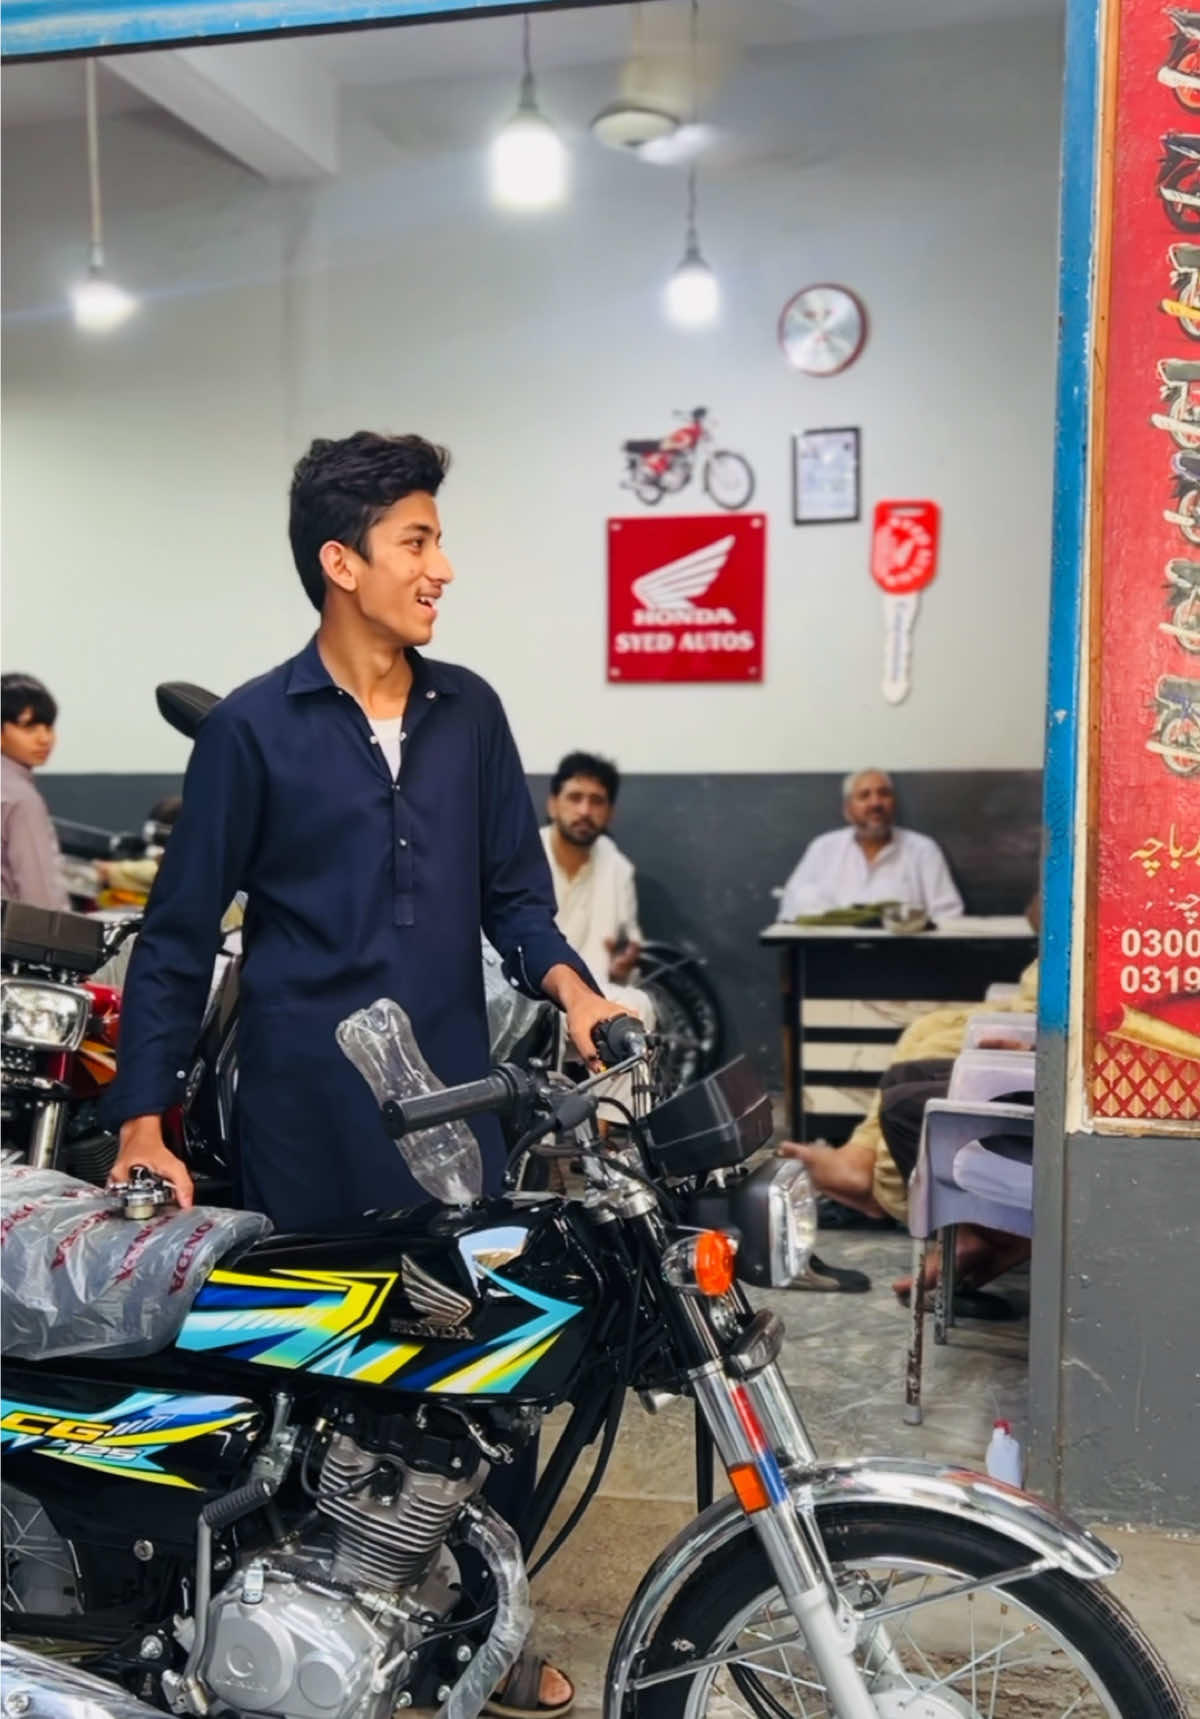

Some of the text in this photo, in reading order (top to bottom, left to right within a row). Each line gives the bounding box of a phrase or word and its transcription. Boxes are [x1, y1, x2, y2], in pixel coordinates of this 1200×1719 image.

[633, 607, 737, 626] HONDA
[678, 630, 755, 652] AUTOS
[1121, 928, 1200, 958] 0300
[1120, 965, 1200, 994] 0319
[0, 1411, 114, 1444] CG
[61, 1441, 144, 1462] 125
